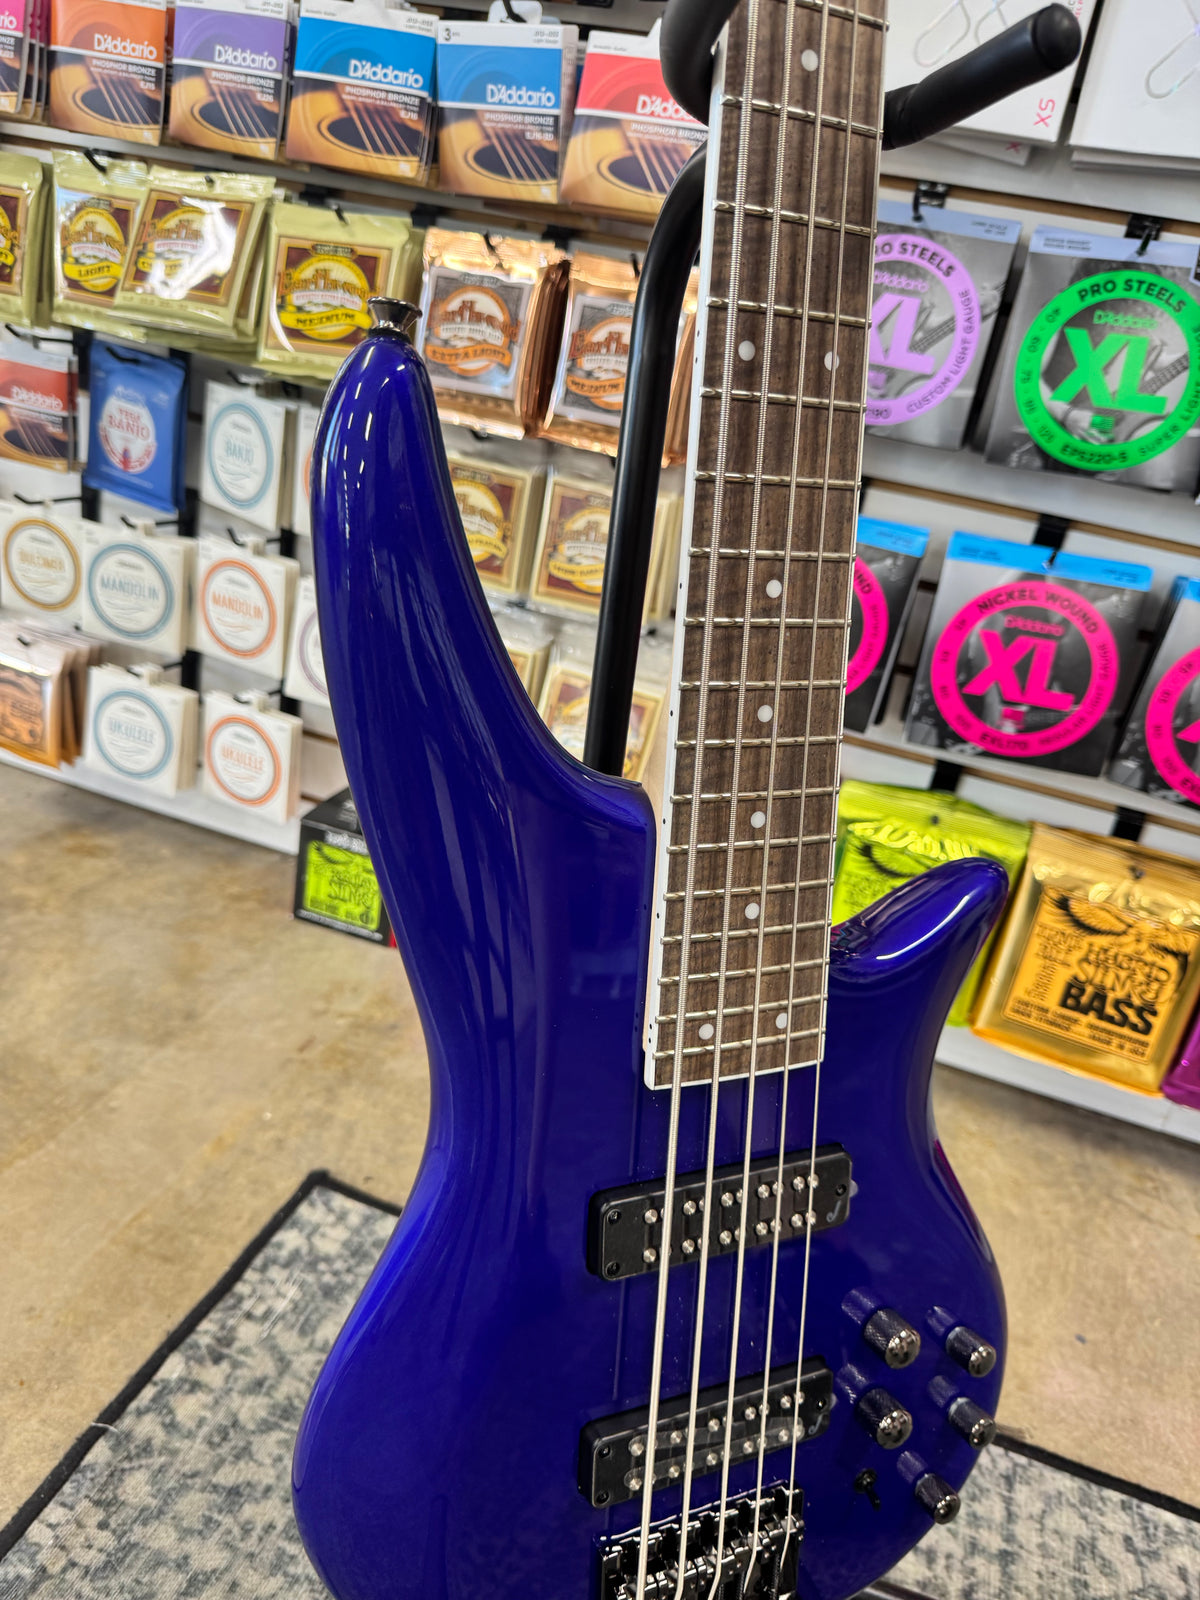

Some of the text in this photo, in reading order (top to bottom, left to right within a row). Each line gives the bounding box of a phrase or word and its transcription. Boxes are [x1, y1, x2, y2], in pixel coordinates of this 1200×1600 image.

[94, 33, 157, 60] D'Addario
[443, 28, 452, 42] 3
[215, 45, 277, 71] D'Addario
[349, 59, 423, 88] D'Addario
[486, 84, 555, 107] D'Addario
[1033, 98, 1056, 127] XS
[898, 242, 955, 278] STEELS
[1077, 278, 1187, 313] PRO STEELS
[296, 312, 356, 325] MEDIUM
[906, 288, 976, 413] CUSTOM LIGHT GAUGE
[1051, 327, 1168, 415] XL
[226, 439, 255, 466] BANJO
[101, 574, 160, 601] MANDOLIN
[211, 590, 264, 621] MANDOLIN
[977, 588, 1099, 633] NICKEL WOUND
[962, 630, 1075, 711] XL
[109, 719, 155, 744] UKULELE
[221, 744, 264, 772] UKULELE
[1059, 981, 1158, 1035] BASS
